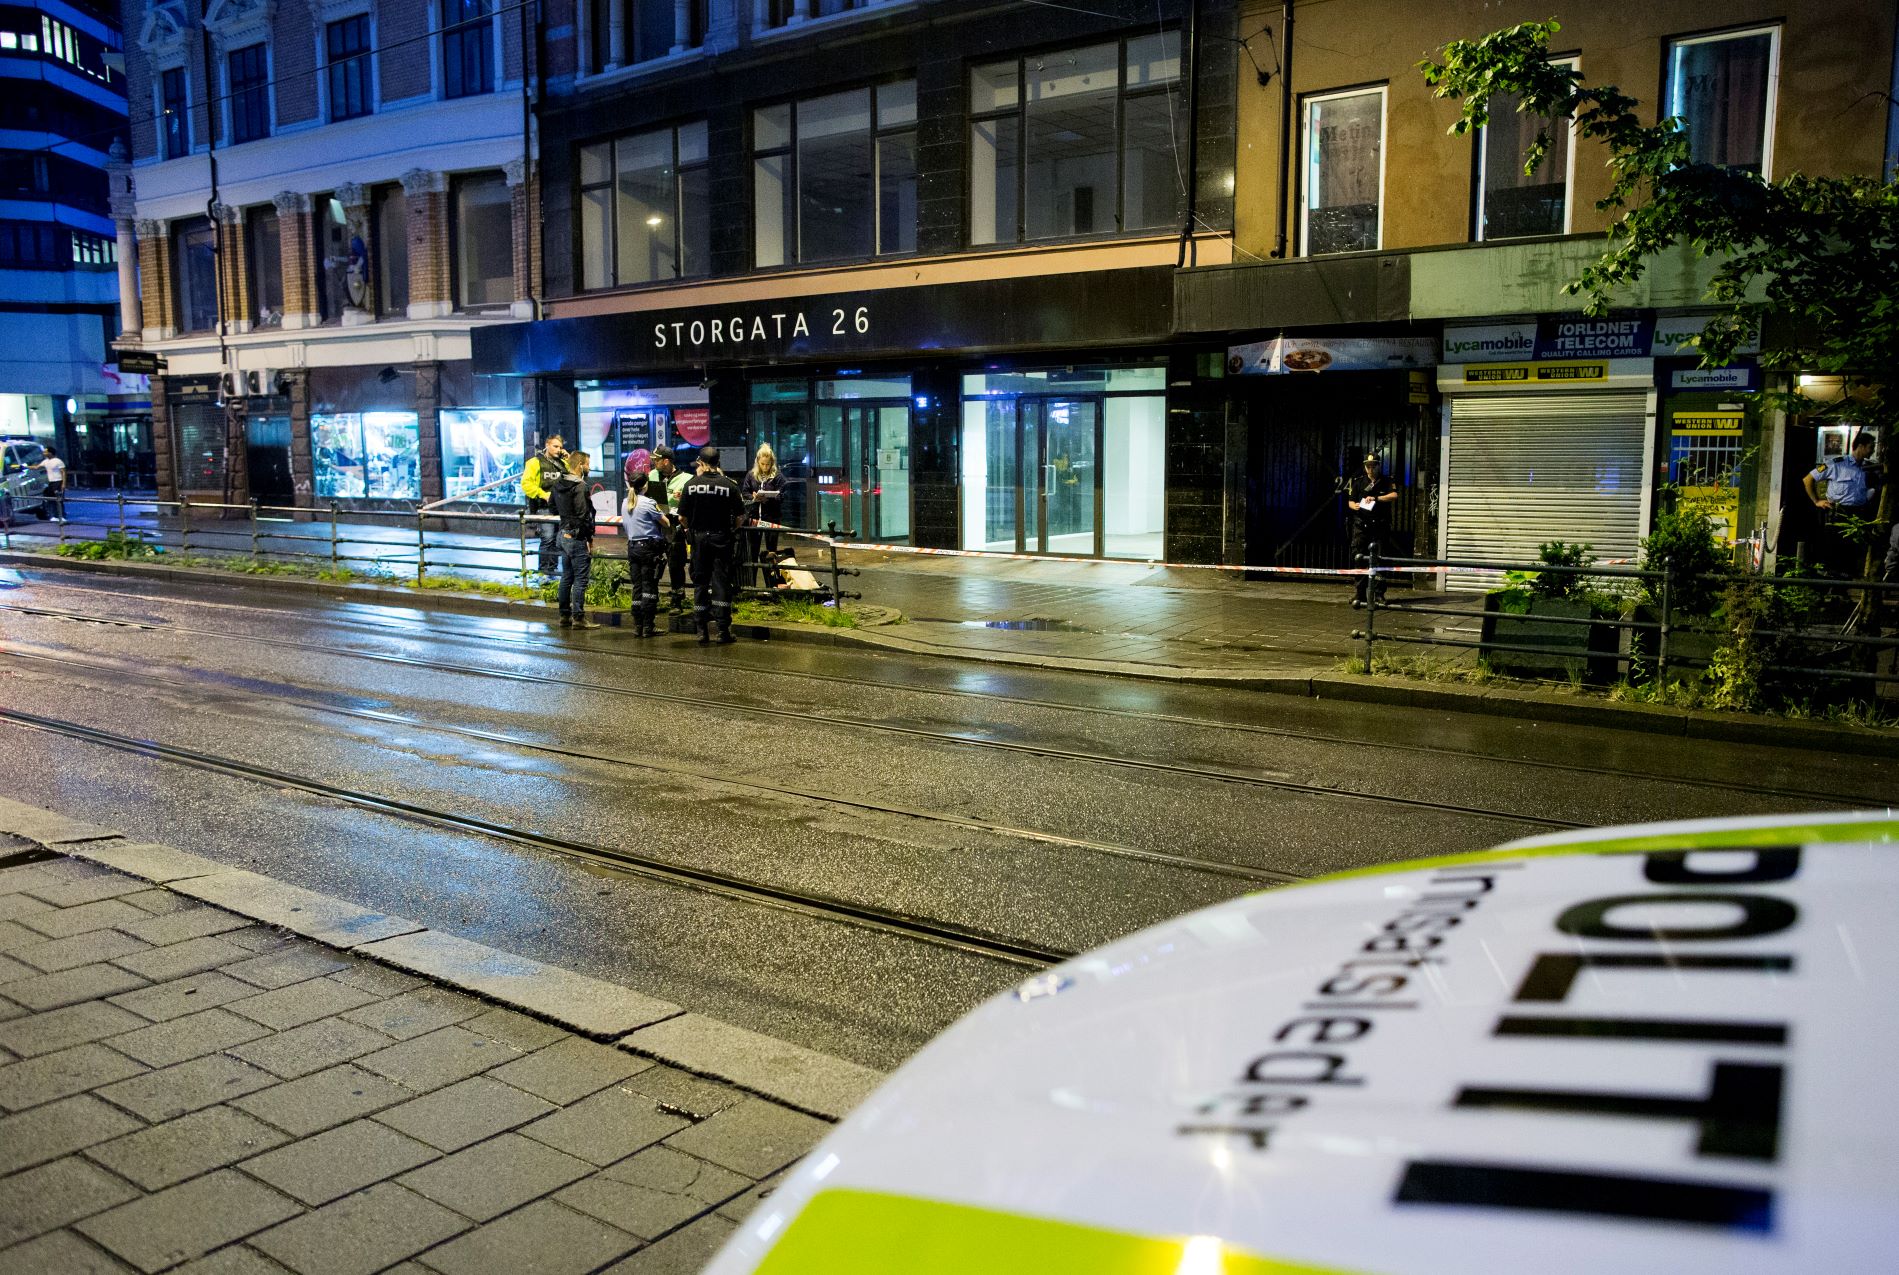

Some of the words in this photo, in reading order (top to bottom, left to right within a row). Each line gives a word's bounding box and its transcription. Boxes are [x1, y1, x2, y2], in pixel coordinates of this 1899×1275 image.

[655, 312, 809, 348] STORGATA
[832, 307, 869, 335] 26
[1654, 327, 1759, 346] Lycae
[1445, 336, 1533, 354] Lycamobile
[1555, 335, 1633, 350] TELECOM
[1541, 350, 1575, 358] QUALITY
[1680, 374, 1738, 384] Lycamobile
[688, 484, 730, 497] POLITI
[1334, 476, 1353, 496] 24
[1392, 845, 1803, 1239] POLITI
